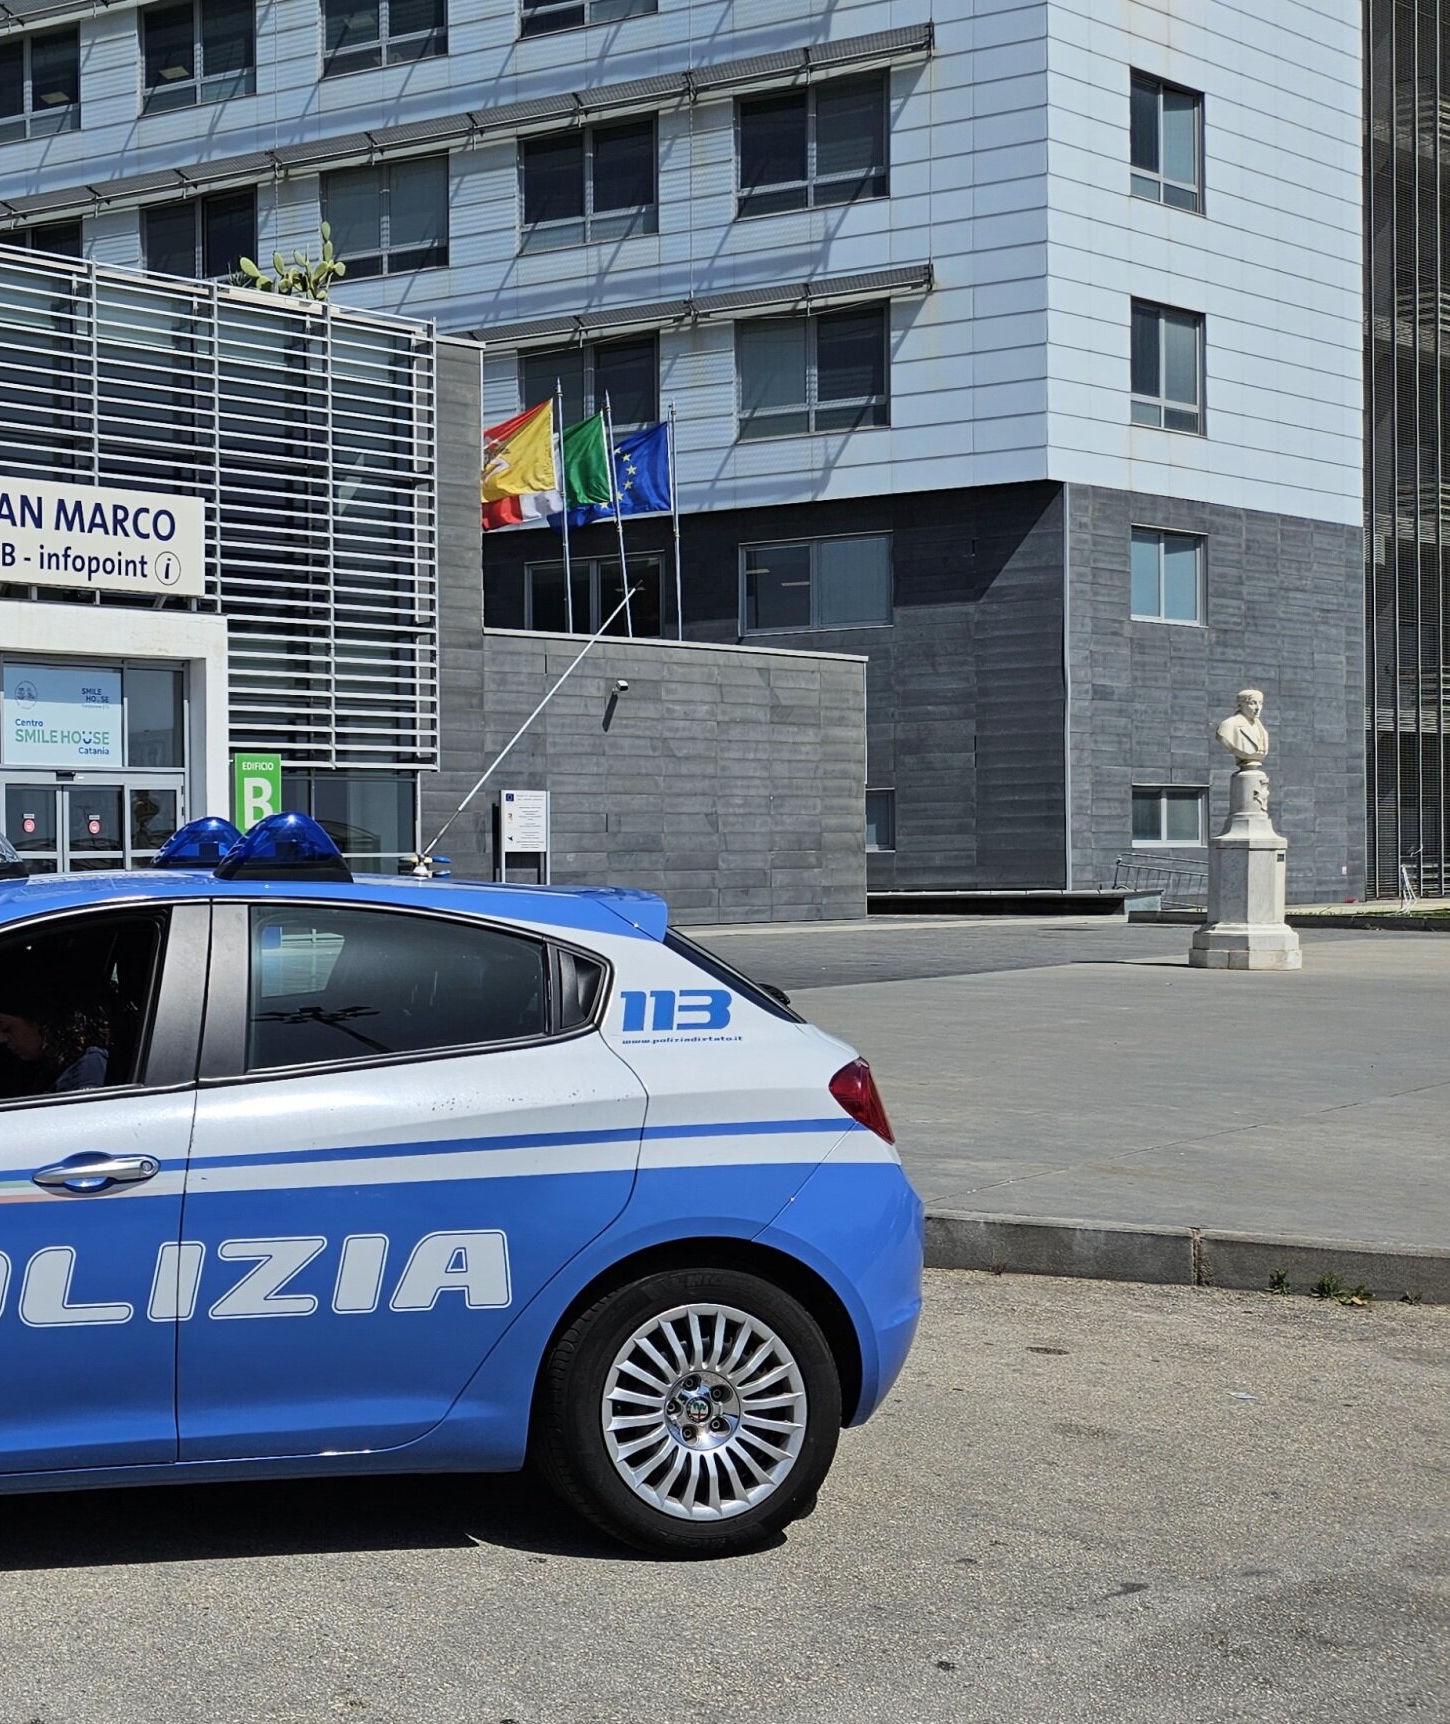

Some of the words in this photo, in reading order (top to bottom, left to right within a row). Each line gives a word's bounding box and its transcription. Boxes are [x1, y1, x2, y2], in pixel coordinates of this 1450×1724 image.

[54, 498, 176, 541] MARCO
[1, 542, 16, 567] B
[39, 544, 148, 582] infopoint
[81, 687, 102, 696] SMILE
[15, 719, 44, 727] Centro
[15, 729, 59, 744] SMILE
[78, 746, 110, 755] Catania
[242, 761, 274, 771] EDIFICIO
[243, 777, 274, 830] B
[620, 989, 733, 1032] 113
